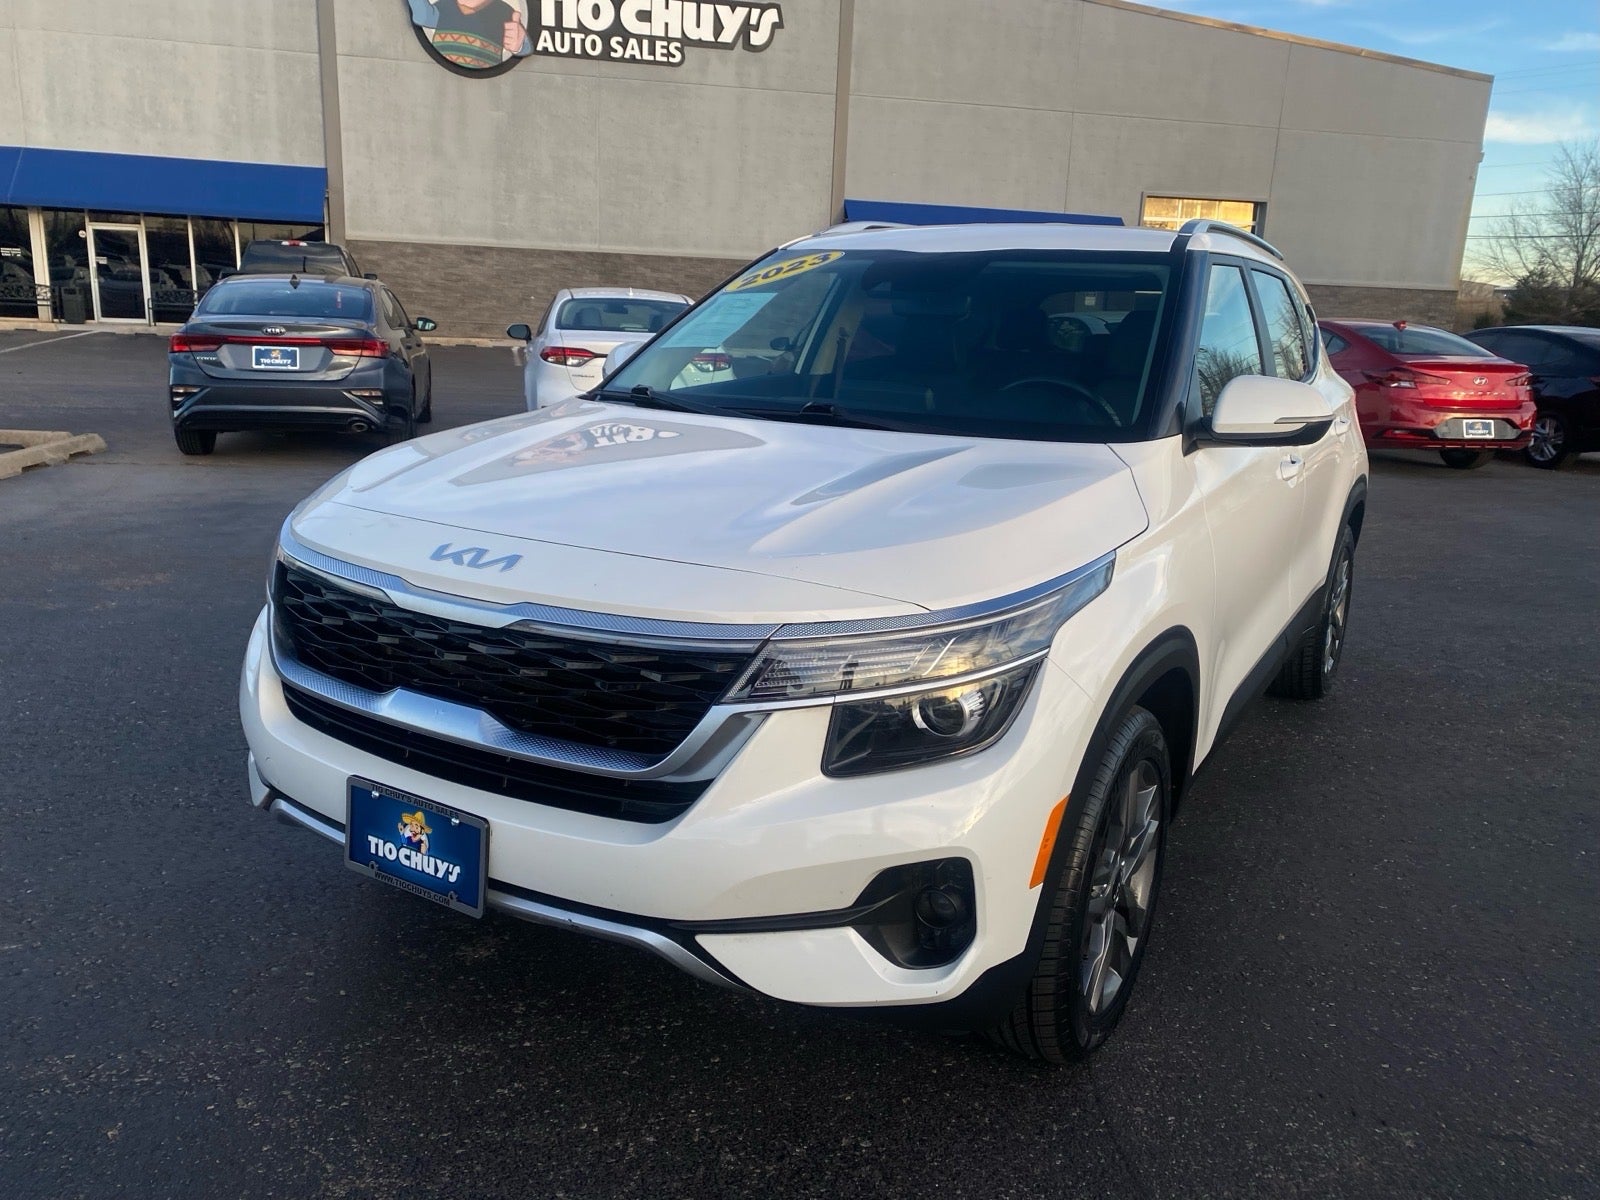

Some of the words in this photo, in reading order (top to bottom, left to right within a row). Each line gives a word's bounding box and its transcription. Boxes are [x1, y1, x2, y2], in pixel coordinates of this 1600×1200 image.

[620, 0, 780, 46] CHUY'S
[536, 30, 603, 56] AUTO
[609, 36, 682, 63] SALES
[738, 253, 831, 289] 2023
[371, 784, 384, 794] TIO
[385, 788, 412, 803] CHUY'S
[413, 799, 434, 811] AUTO
[435, 806, 460, 820] SALES
[367, 834, 398, 861] TIO
[398, 847, 461, 883] CHUY'S
[374, 870, 451, 907] WWW.TIOCHUYS.COM
